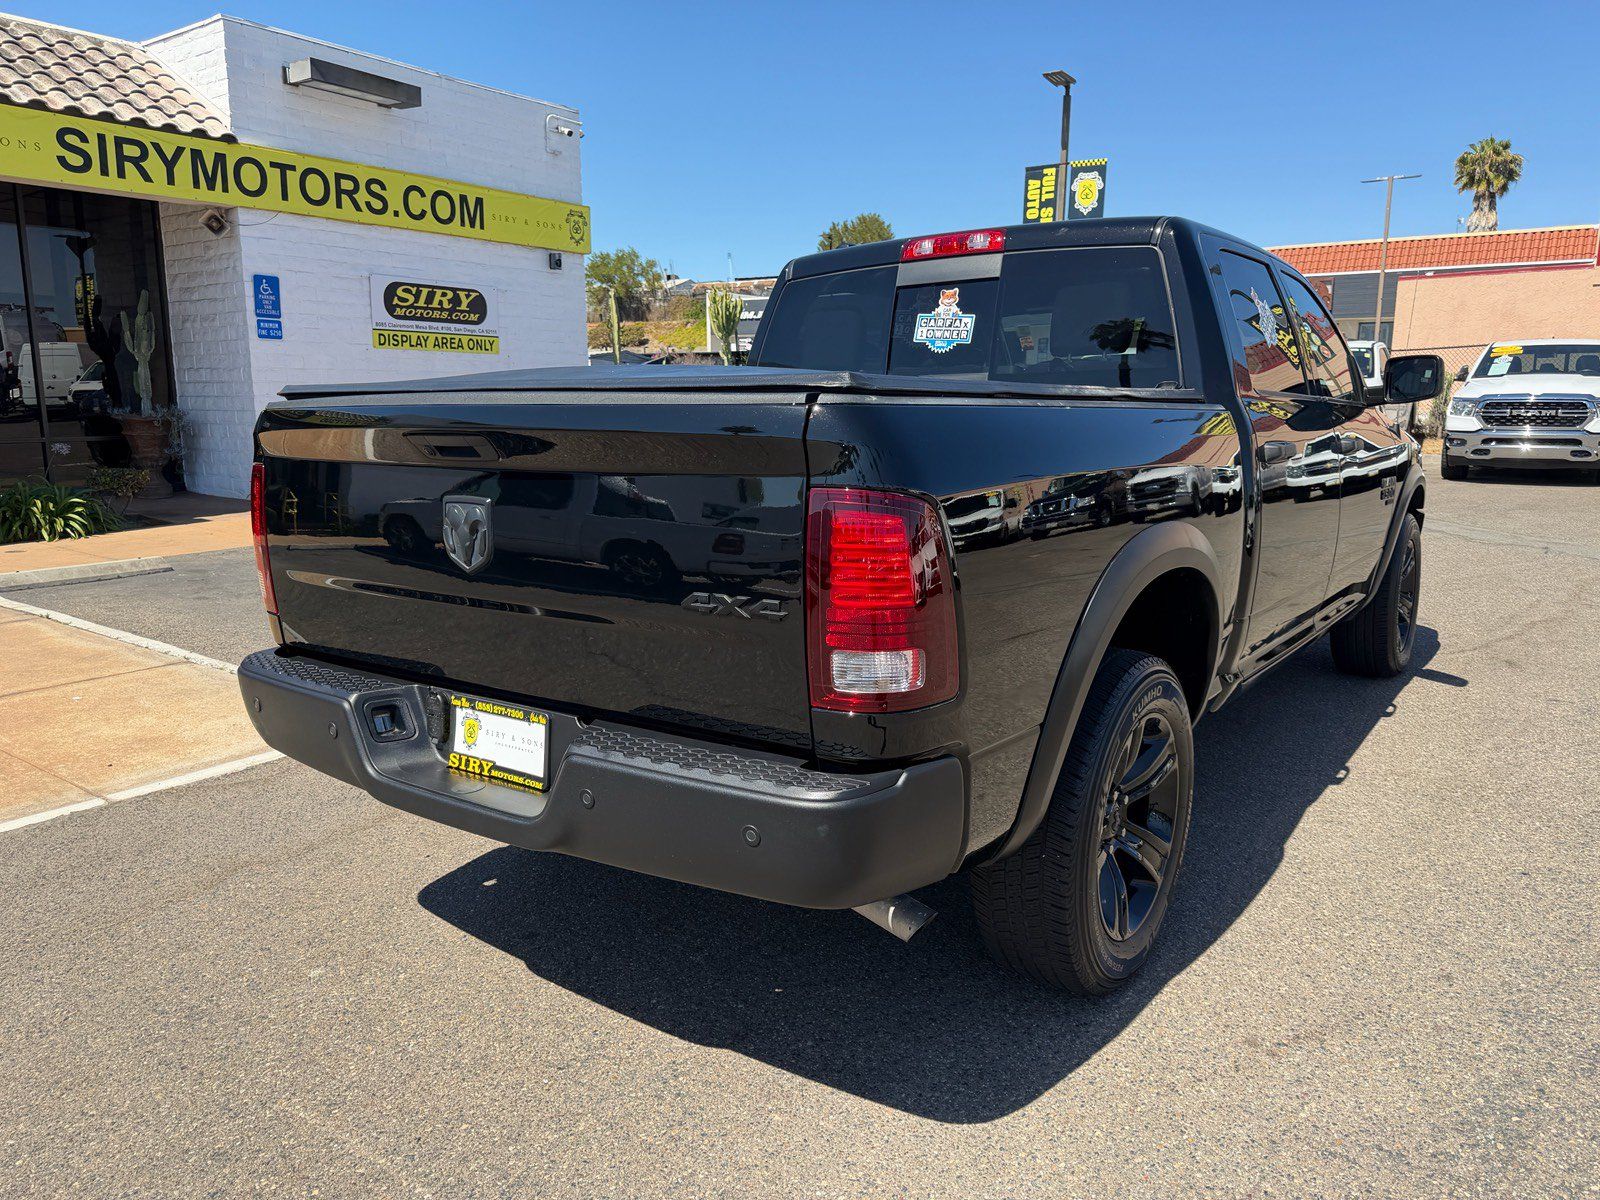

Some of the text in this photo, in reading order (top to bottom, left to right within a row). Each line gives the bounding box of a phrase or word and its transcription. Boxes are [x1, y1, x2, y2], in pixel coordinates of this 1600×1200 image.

[56, 126, 485, 231] SIRYMOTORS.COM
[1041, 167, 1056, 202] FULL
[1026, 179, 1041, 220] AUTO
[491, 213, 563, 232] SIRY & SONS
[392, 285, 480, 311] SIRY
[393, 307, 481, 322] MOTORS.COM
[920, 317, 970, 329] CARFAX
[378, 333, 495, 352] DISPLAY AREA ONLY
[1132, 685, 1163, 722] KUMHO
[485, 729, 506, 740] SIRY
[521, 737, 544, 749] SONS
[448, 752, 544, 790] SIRY MOTORS.COM
